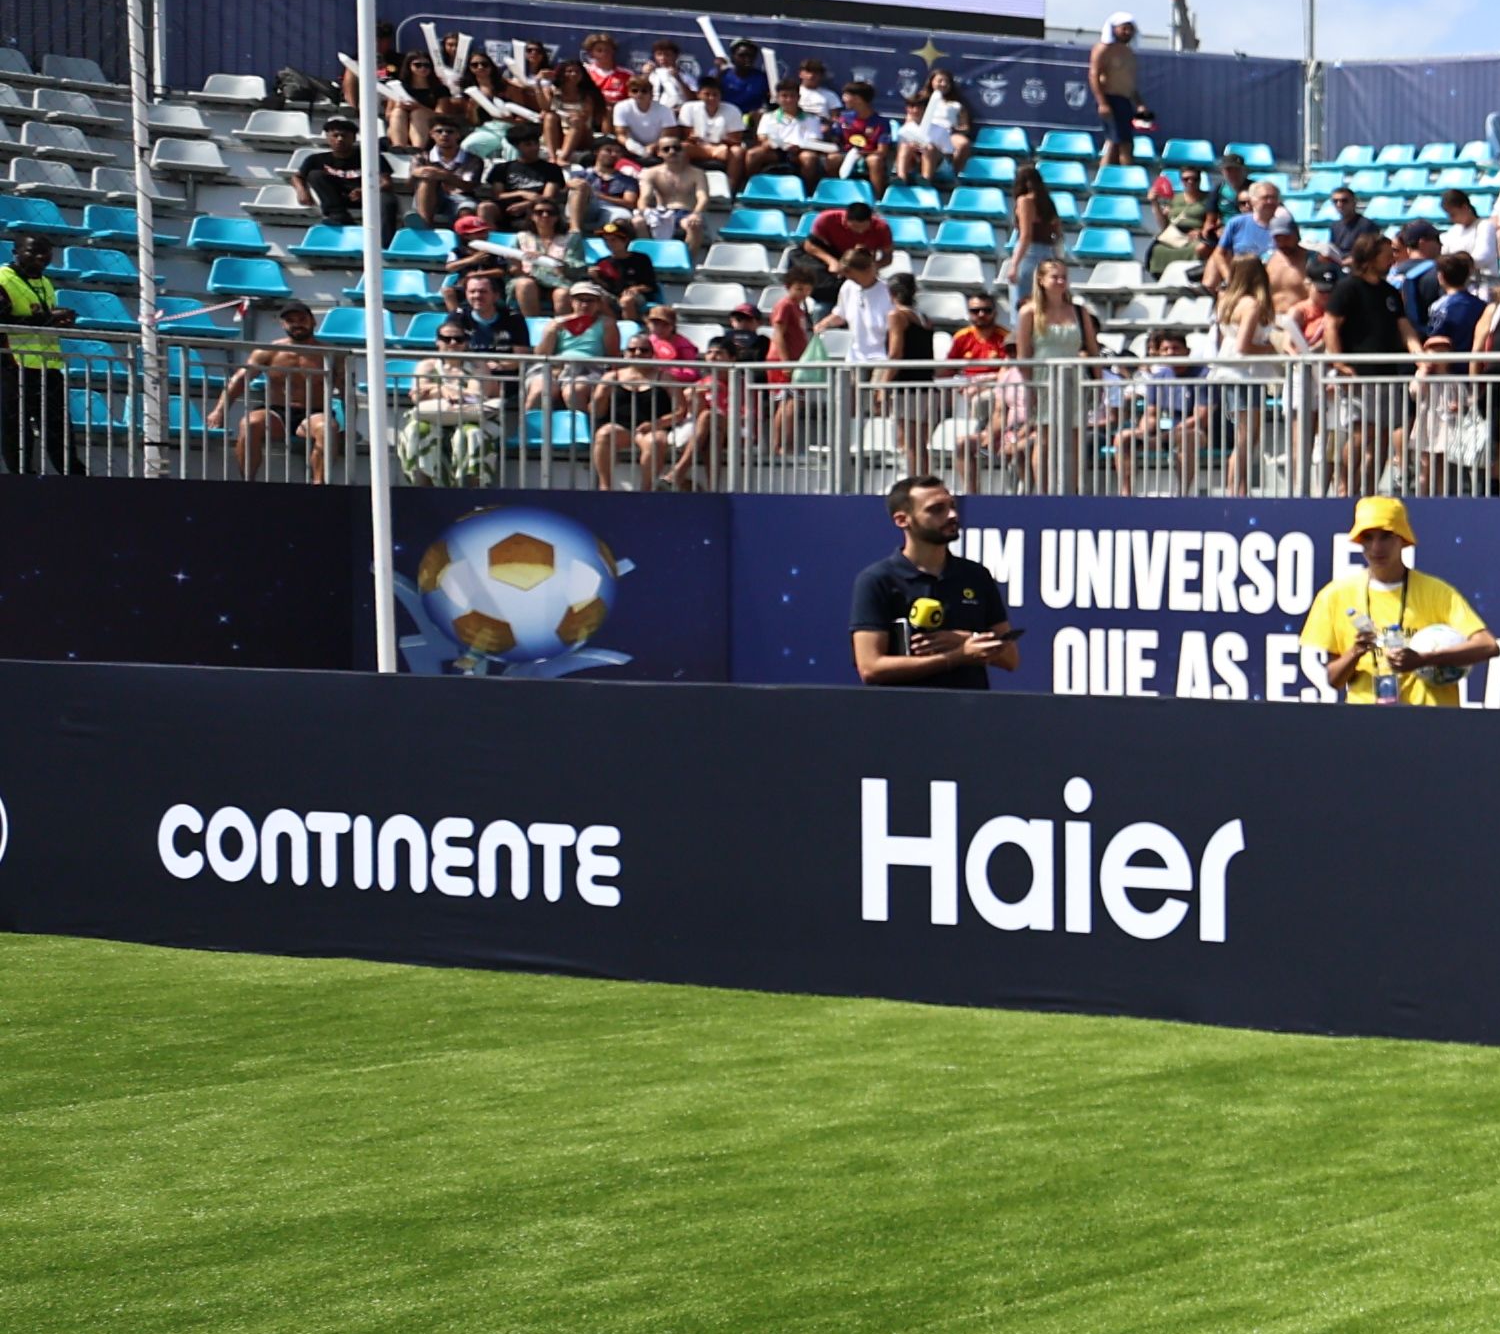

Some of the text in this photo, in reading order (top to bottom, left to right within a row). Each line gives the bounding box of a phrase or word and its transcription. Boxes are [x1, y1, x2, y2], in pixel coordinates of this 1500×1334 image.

[1040, 528, 1314, 615] UNIVERSO
[1053, 626, 1160, 696] QUE
[1176, 630, 1249, 701] AS
[158, 803, 622, 907] CONTINENTE
[861, 777, 1245, 943] Haier
